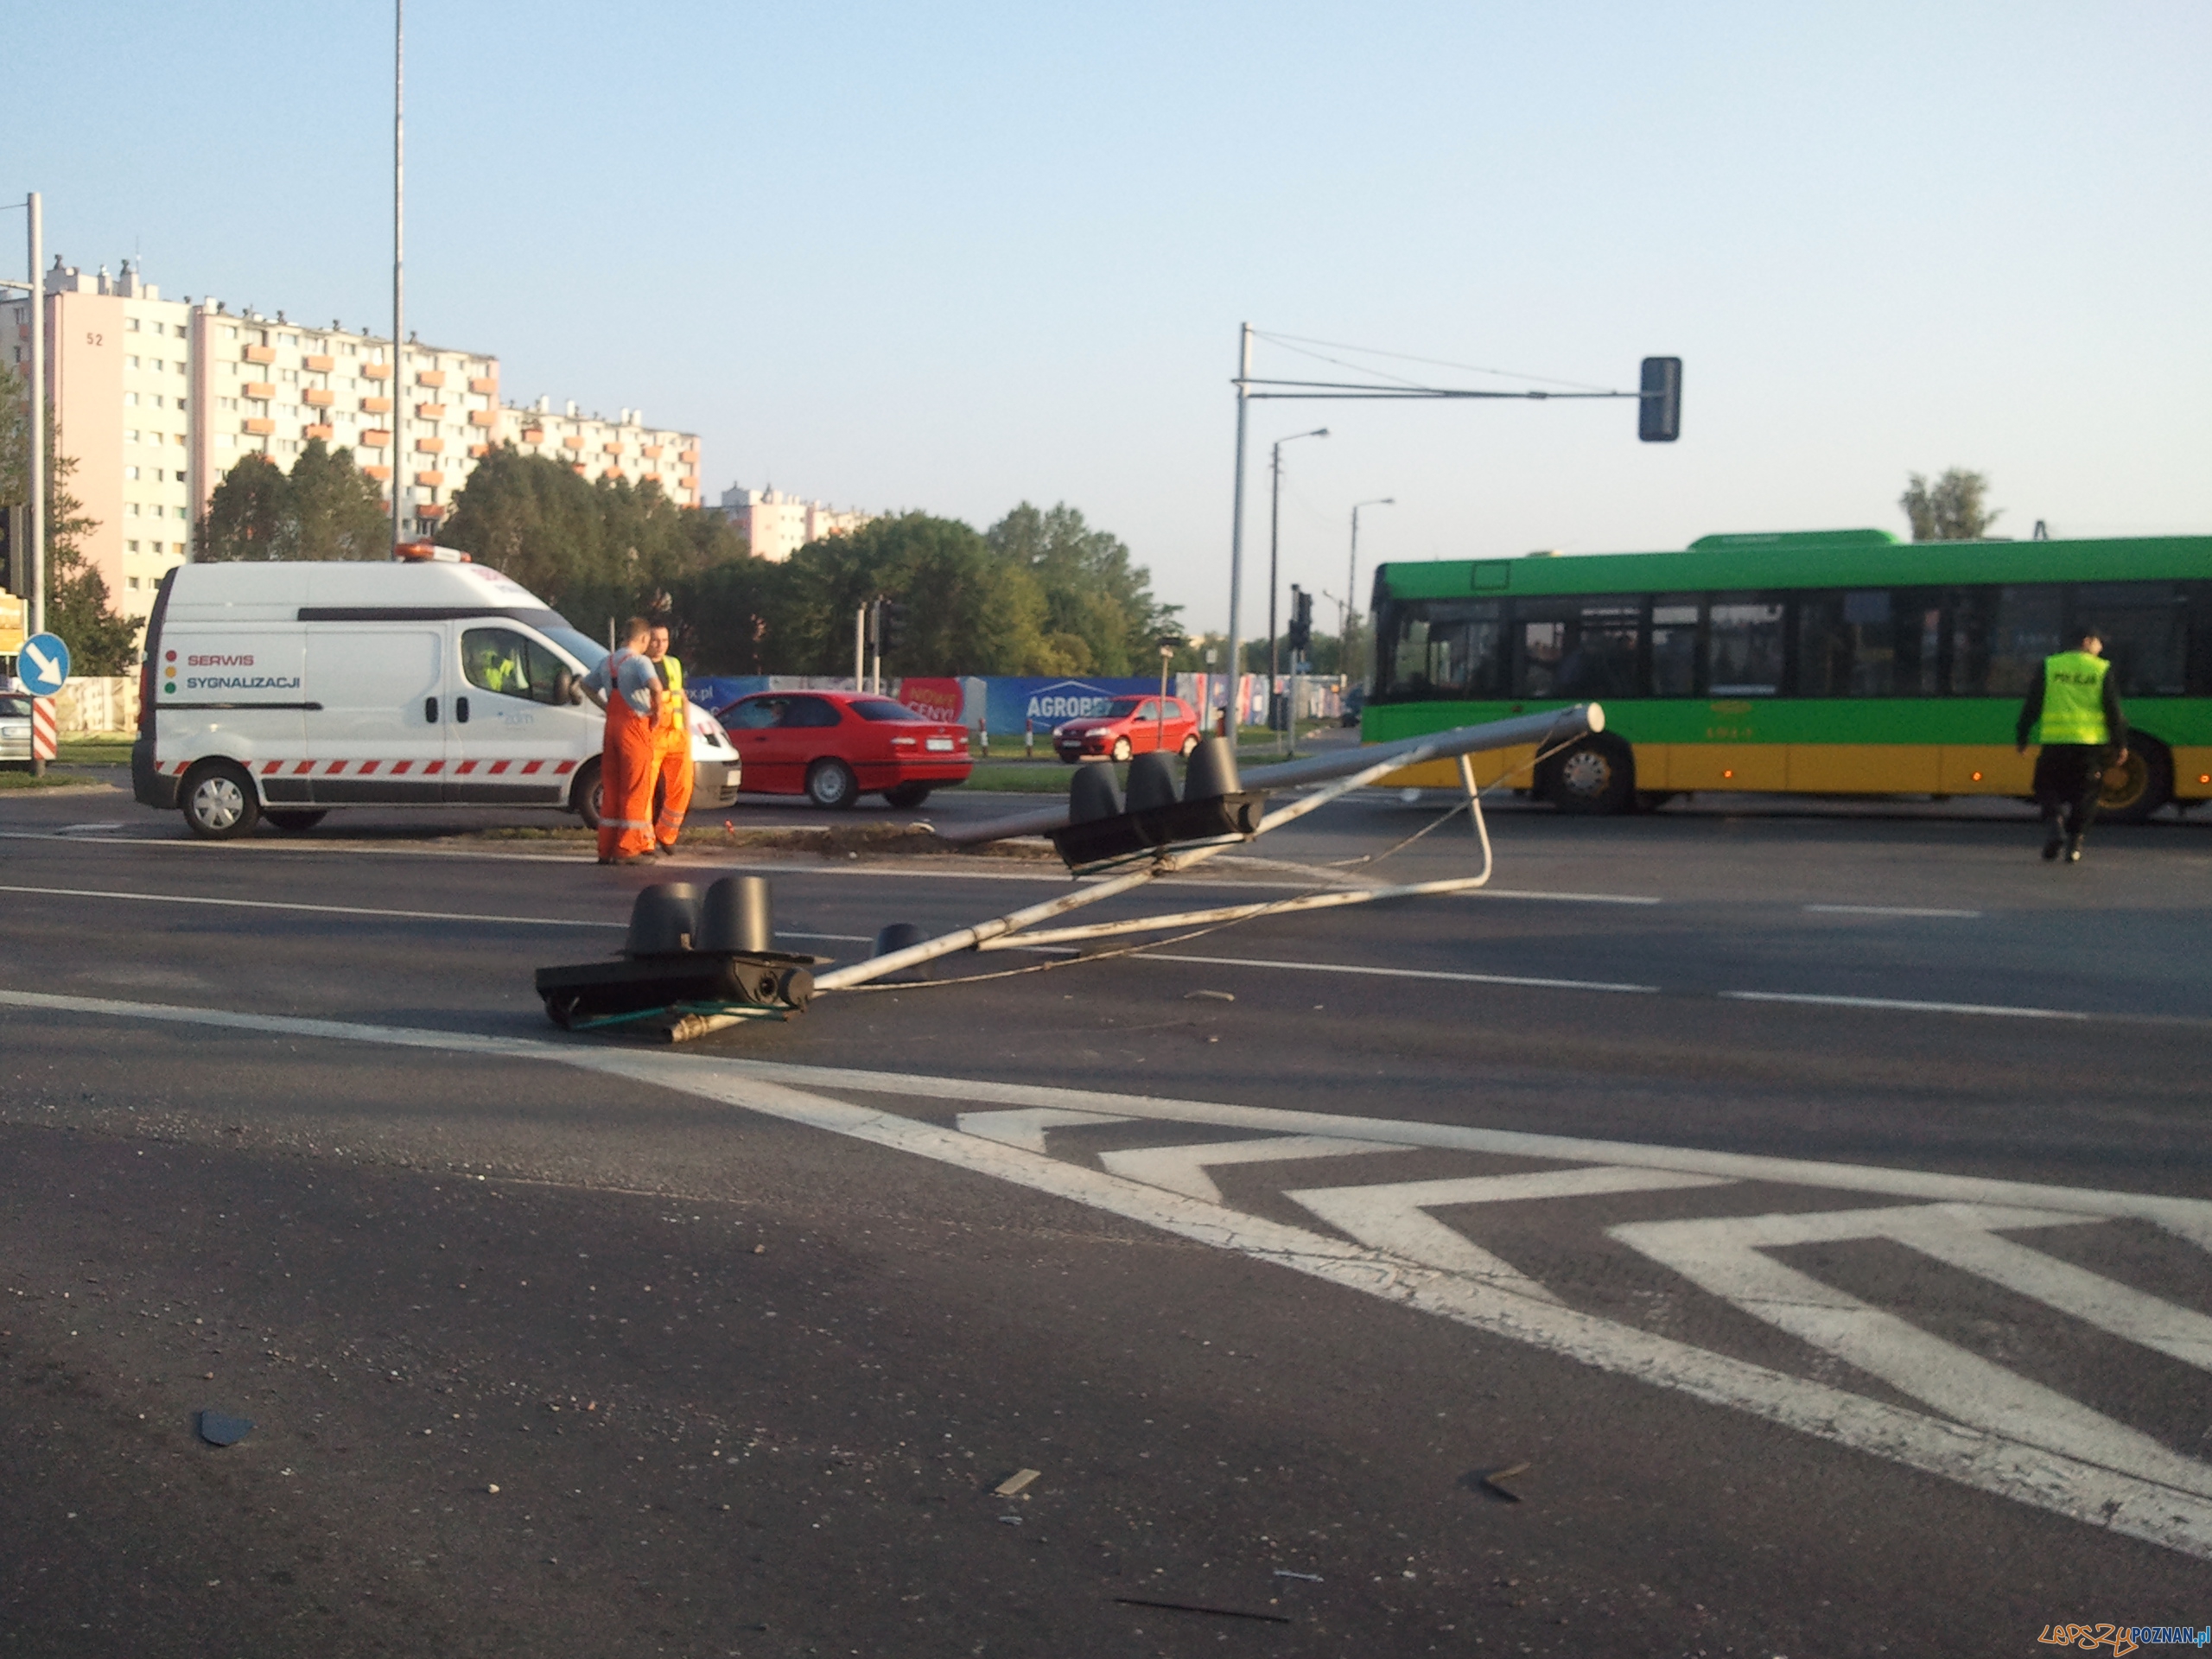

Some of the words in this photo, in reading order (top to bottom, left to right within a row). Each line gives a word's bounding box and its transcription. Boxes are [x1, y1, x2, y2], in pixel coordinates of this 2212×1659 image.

[86, 332, 103, 346] 52
[188, 655, 255, 666] SERWIS
[187, 677, 300, 689] SYGNALIZACJI
